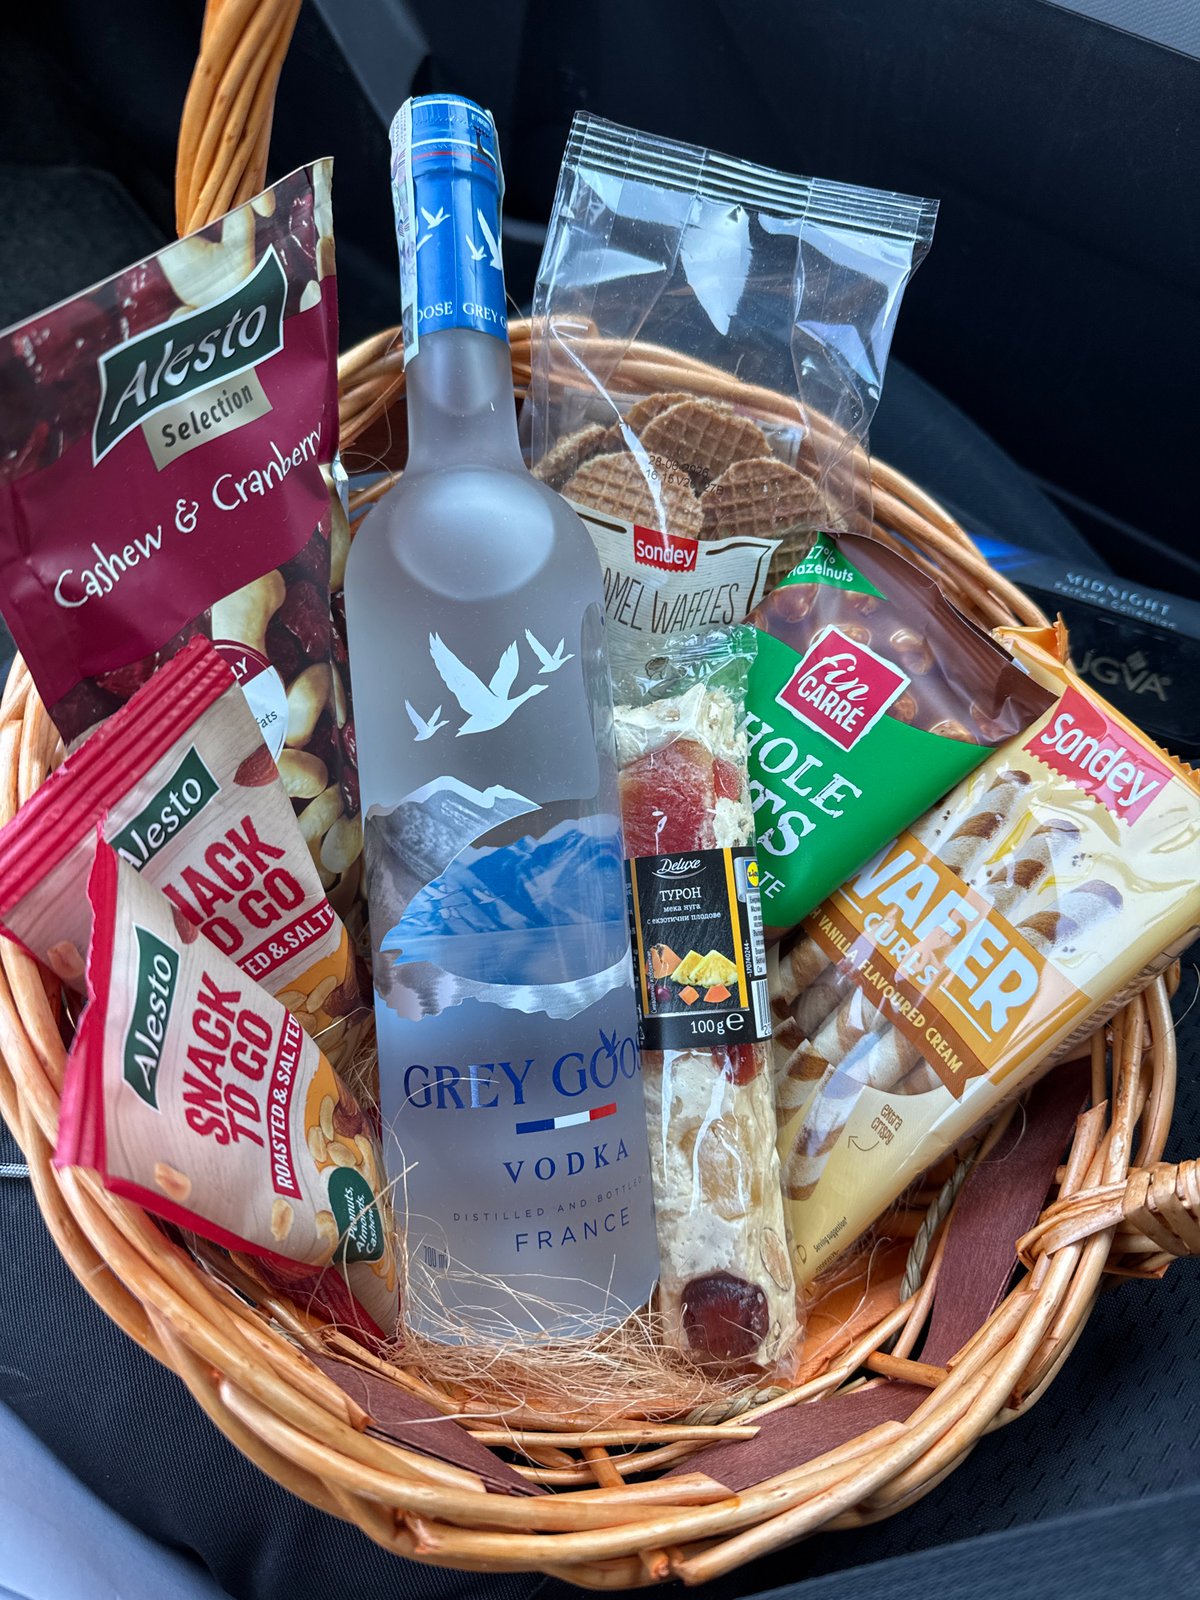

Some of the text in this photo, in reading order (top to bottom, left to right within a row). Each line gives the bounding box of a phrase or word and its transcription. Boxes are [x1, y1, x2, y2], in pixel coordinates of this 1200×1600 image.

[462, 302, 498, 324] GREY
[109, 304, 267, 426] Alesto
[161, 381, 254, 448] Selection
[54, 525, 163, 610] Cashew
[175, 499, 200, 533] &
[636, 540, 695, 567] Sondey
[654, 583, 740, 634] WAFFLES
[1065, 572, 1170, 616] MIDNIGHT
[798, 675, 865, 733] CARRÉ
[1040, 712, 1160, 807] Sondey
[657, 857, 701, 875] Deluxe
[238, 867, 306, 929] GO
[659, 886, 702, 902] ТУРОН
[268, 942, 289, 960] &
[863, 911, 939, 986] CURLS
[132, 953, 172, 1088] Alesto
[818, 916, 859, 963] VANILLA
[858, 958, 926, 1029] FLAVOURED
[925, 1027, 963, 1074] CREAM
[183, 970, 242, 1146] SNACK
[223, 1008, 273, 1148] TO GO
[271, 1013, 300, 1190] ROASTED & SALTED
[403, 1059, 535, 1109] GREY
[871, 1117, 895, 1146] crispy
[881, 1104, 903, 1131] extra
[502, 1138, 630, 1184] VODKA
[453, 1176, 642, 1222] DISTILLED AND BOTTLED
[515, 1207, 630, 1252] FRANCE
